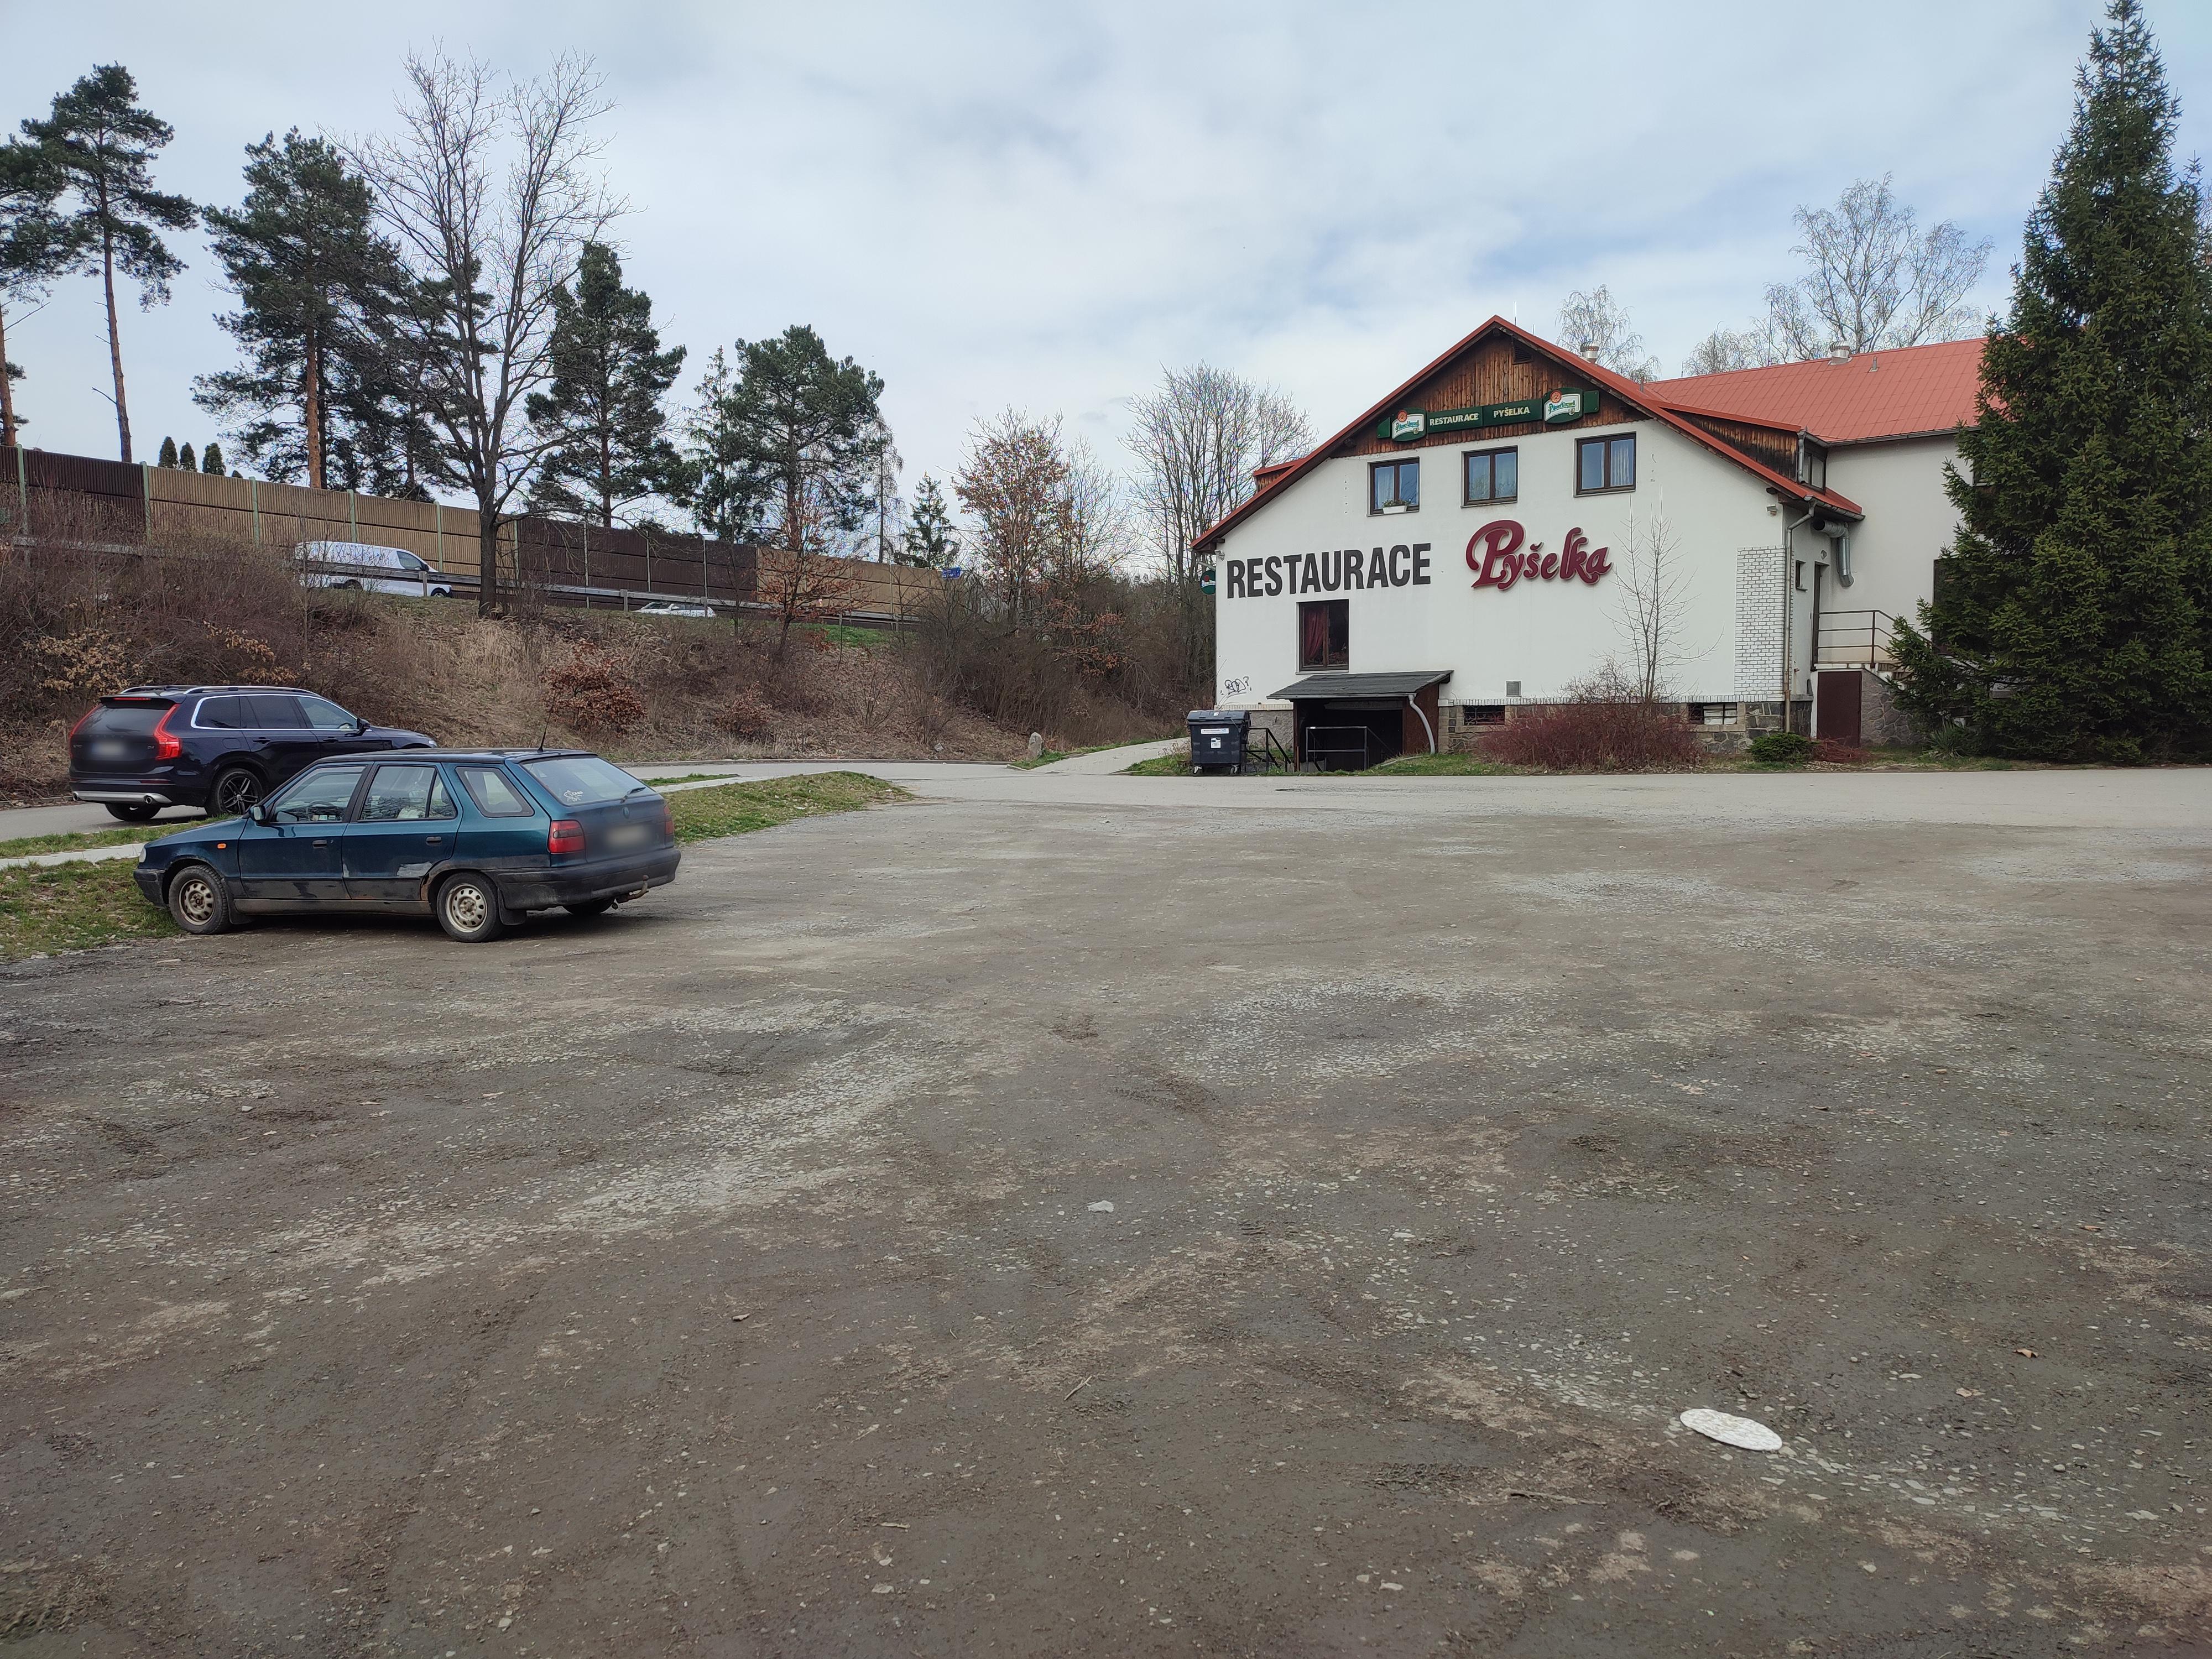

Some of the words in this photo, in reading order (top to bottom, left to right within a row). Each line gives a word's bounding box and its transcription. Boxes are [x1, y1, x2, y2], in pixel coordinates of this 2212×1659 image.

[1430, 413, 1479, 426] RESTAURACE
[1493, 406, 1530, 418] PYŠELKA
[1227, 542, 1431, 599] RESTAURACE
[1465, 519, 1613, 591] Pyšelka
